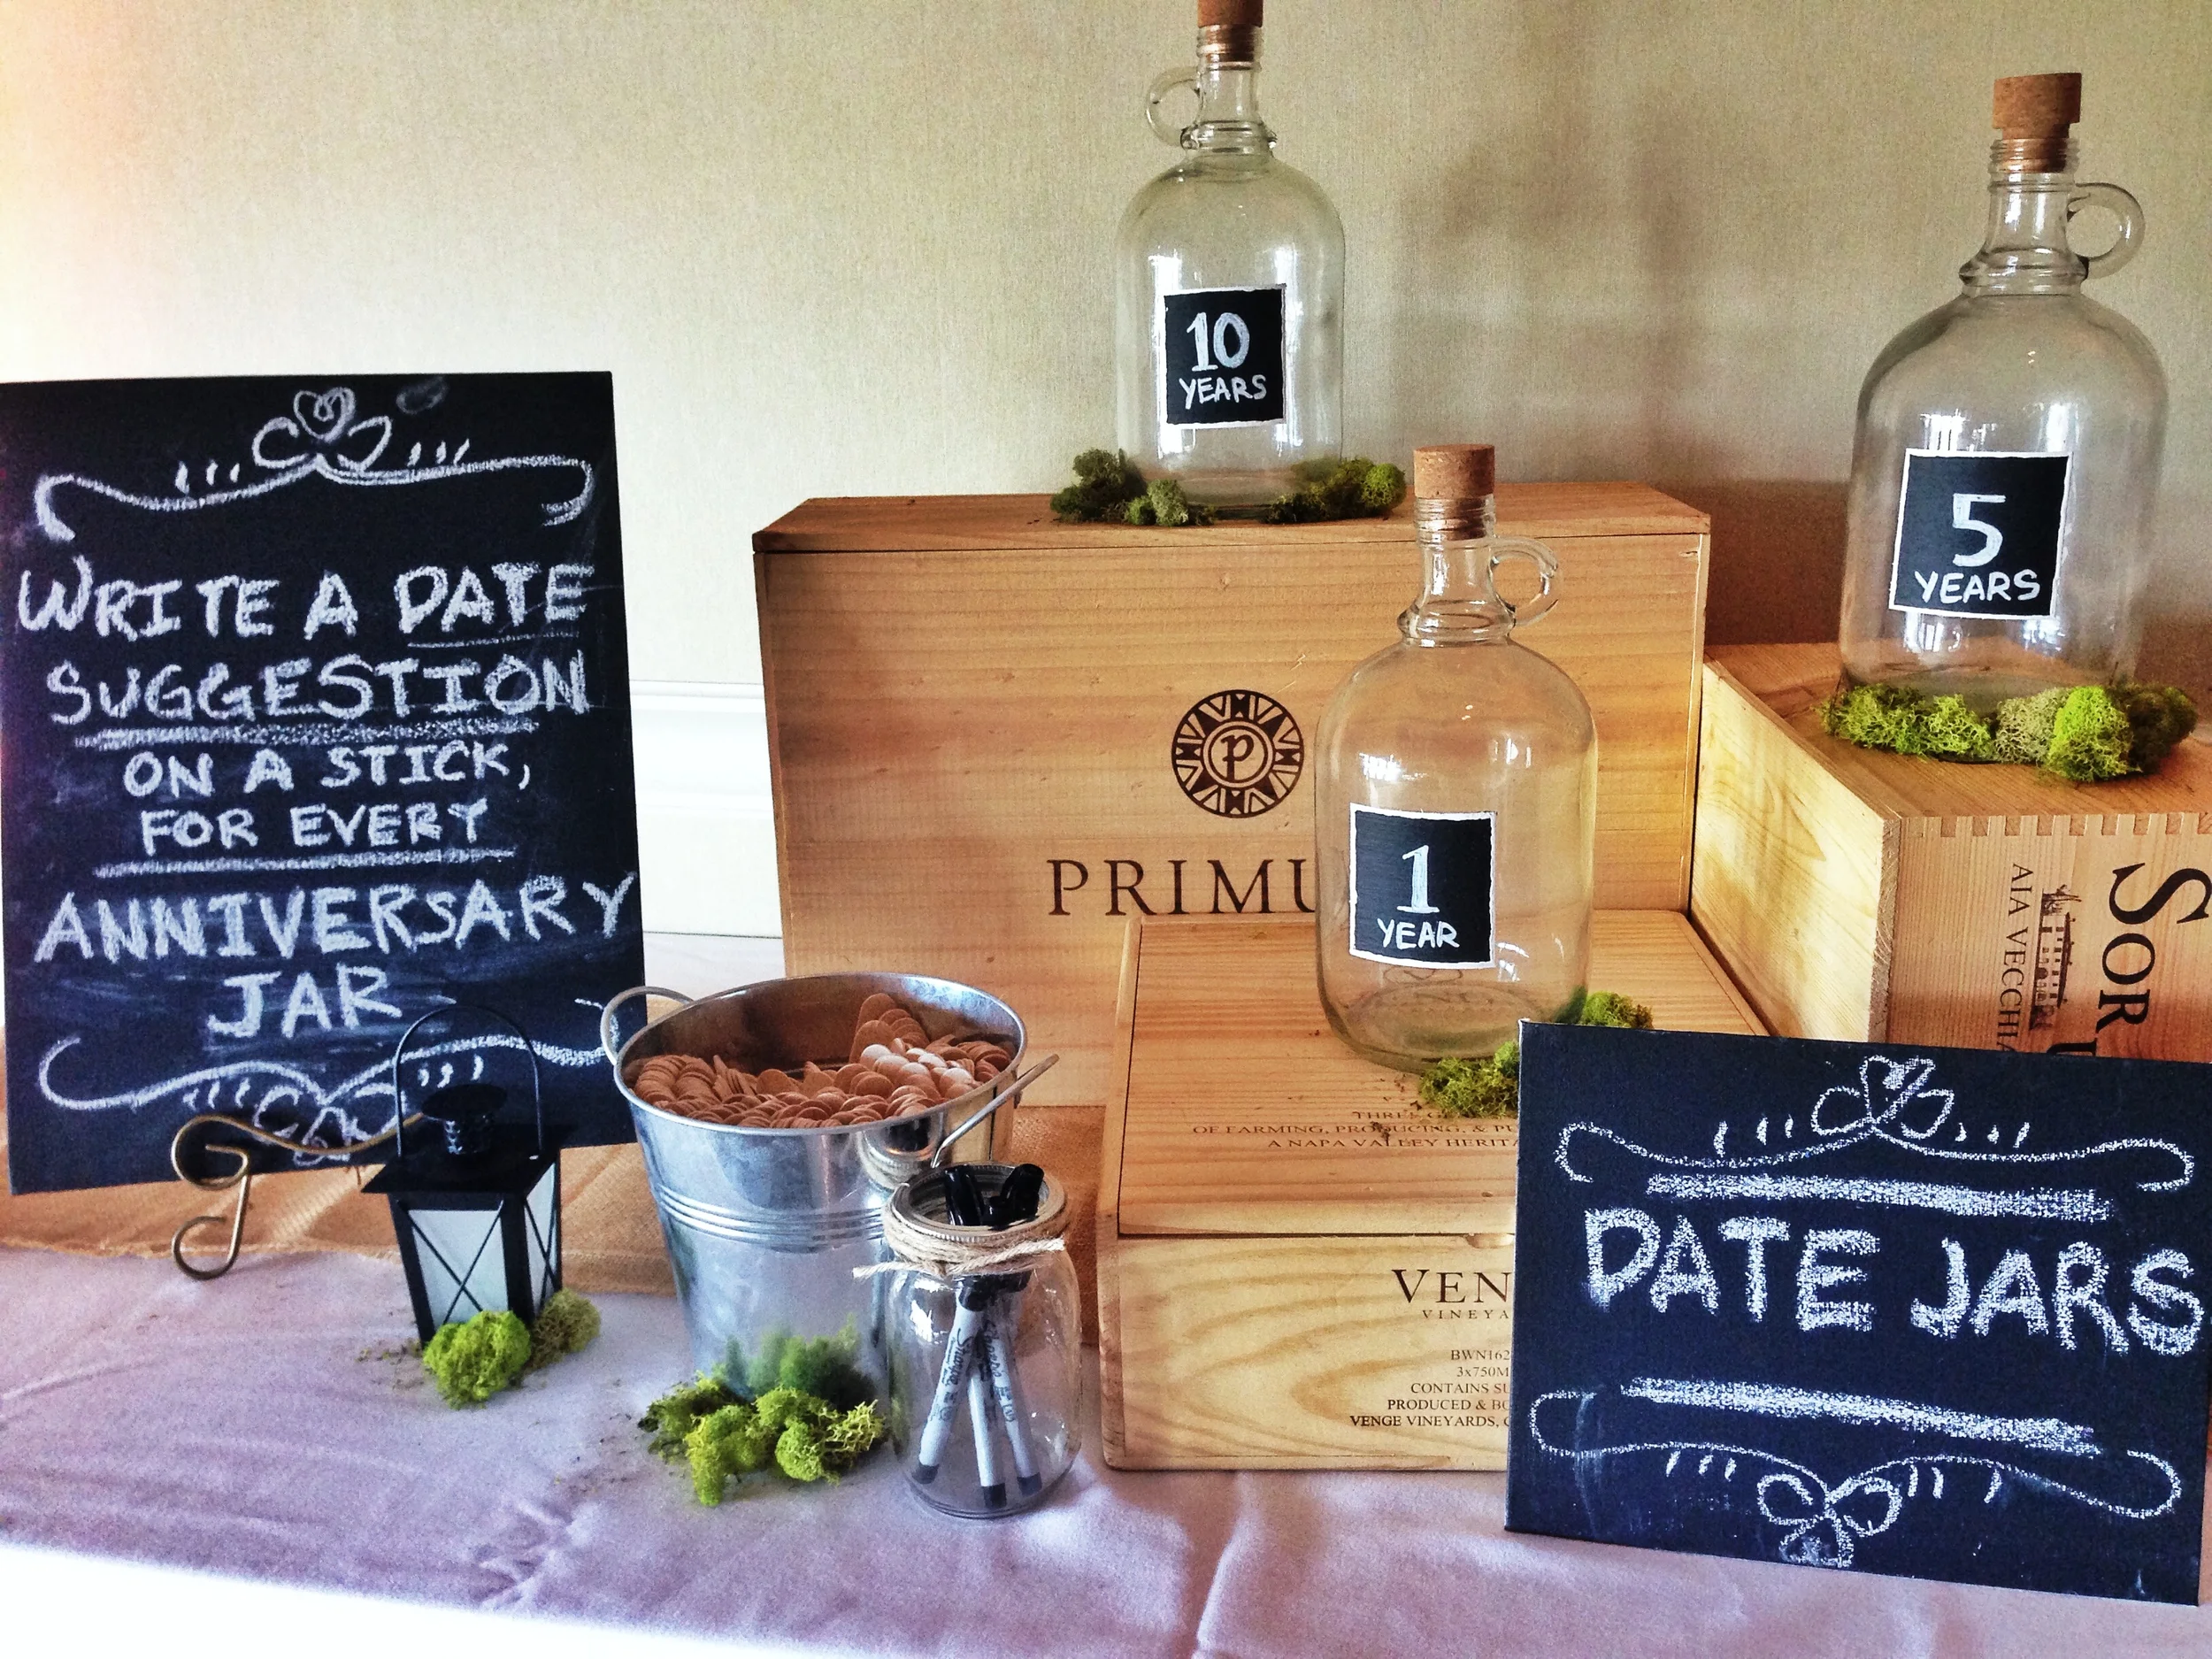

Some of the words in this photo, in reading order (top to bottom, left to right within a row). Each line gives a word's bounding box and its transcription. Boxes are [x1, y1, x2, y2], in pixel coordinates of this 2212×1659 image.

[1187, 311, 1250, 372] 10
[1179, 374, 1267, 410] YEARS
[1952, 493, 2006, 567] 5
[18, 555, 280, 642] WRITE
[304, 571, 358, 640] A
[394, 562, 595, 634] DATE
[1915, 569, 2040, 603] YEARS
[46, 650, 588, 723] SUGGESTION
[124, 750, 213, 796] ON
[244, 750, 293, 794] A
[322, 741, 530, 790] STICK,
[142, 809, 257, 855] FOR
[291, 798, 488, 848] EVERY
[1396, 845, 1440, 914] 1
[2008, 863, 2034, 917] AIA
[34, 872, 639, 964] ANNIVERSARY
[1377, 918, 1460, 950] YEAR
[207, 963, 403, 1039] JAR
[1193, 1125, 1220, 1134] OF
[1226, 1124, 1329, 1135] FARMING,
[1472, 1124, 1486, 1133] &
[1268, 1138, 1282, 1148] A
[1288, 1138, 1346, 1148] NAPA
[1353, 1138, 1440, 1148] VALLEY
[1391, 1269, 1512, 1303] VEN
[1583, 1207, 1880, 1332] DATE
[1910, 1237, 2205, 1356] JARS
[1387, 1399, 1471, 1410] PRODUCED
[1475, 1399, 1487, 1410] &
[1410, 1382, 1489, 1394] CONTAINS
[1349, 1415, 1402, 1427] VENGE
[1407, 1415, 1500, 1429] VINEYARDS,
